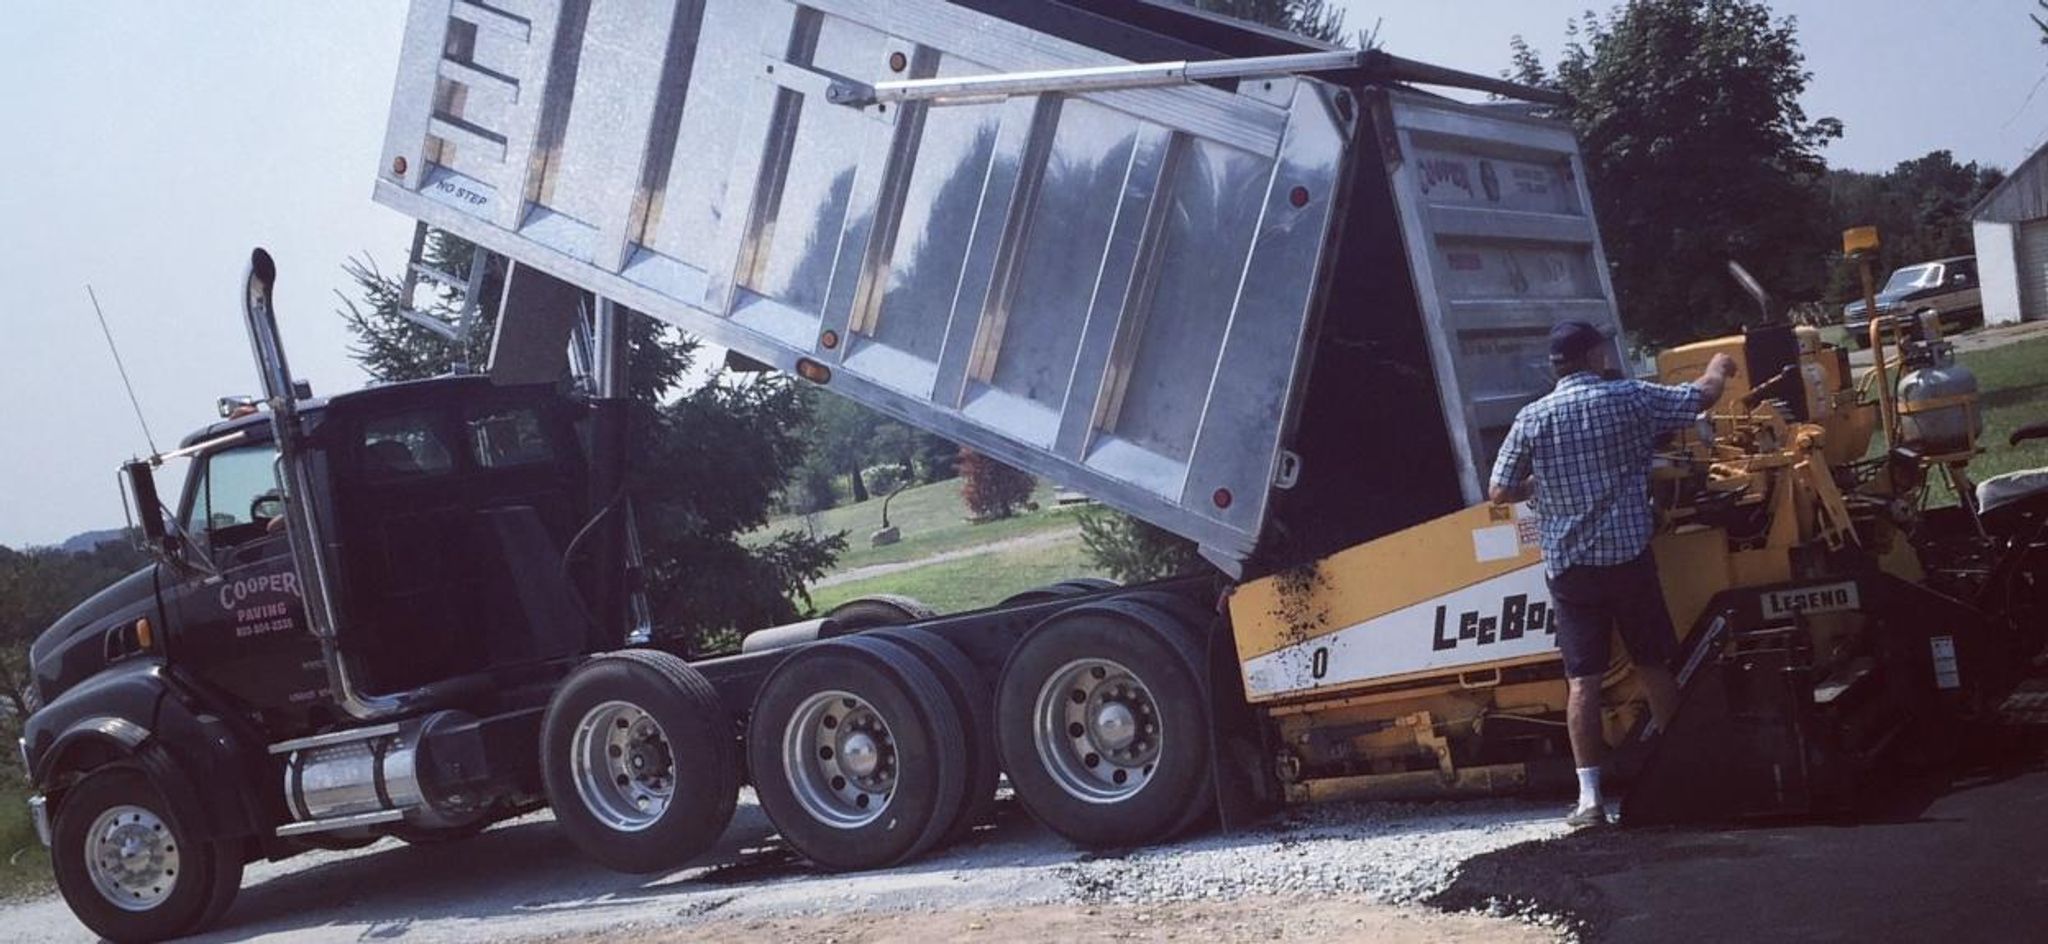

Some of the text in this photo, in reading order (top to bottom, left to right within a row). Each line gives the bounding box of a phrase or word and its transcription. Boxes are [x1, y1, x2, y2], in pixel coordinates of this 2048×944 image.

[435, 180, 488, 206] NO STEP
[220, 572, 302, 610] COOPER
[1769, 588, 1848, 613] LEGEND
[237, 602, 287, 622] PAVING
